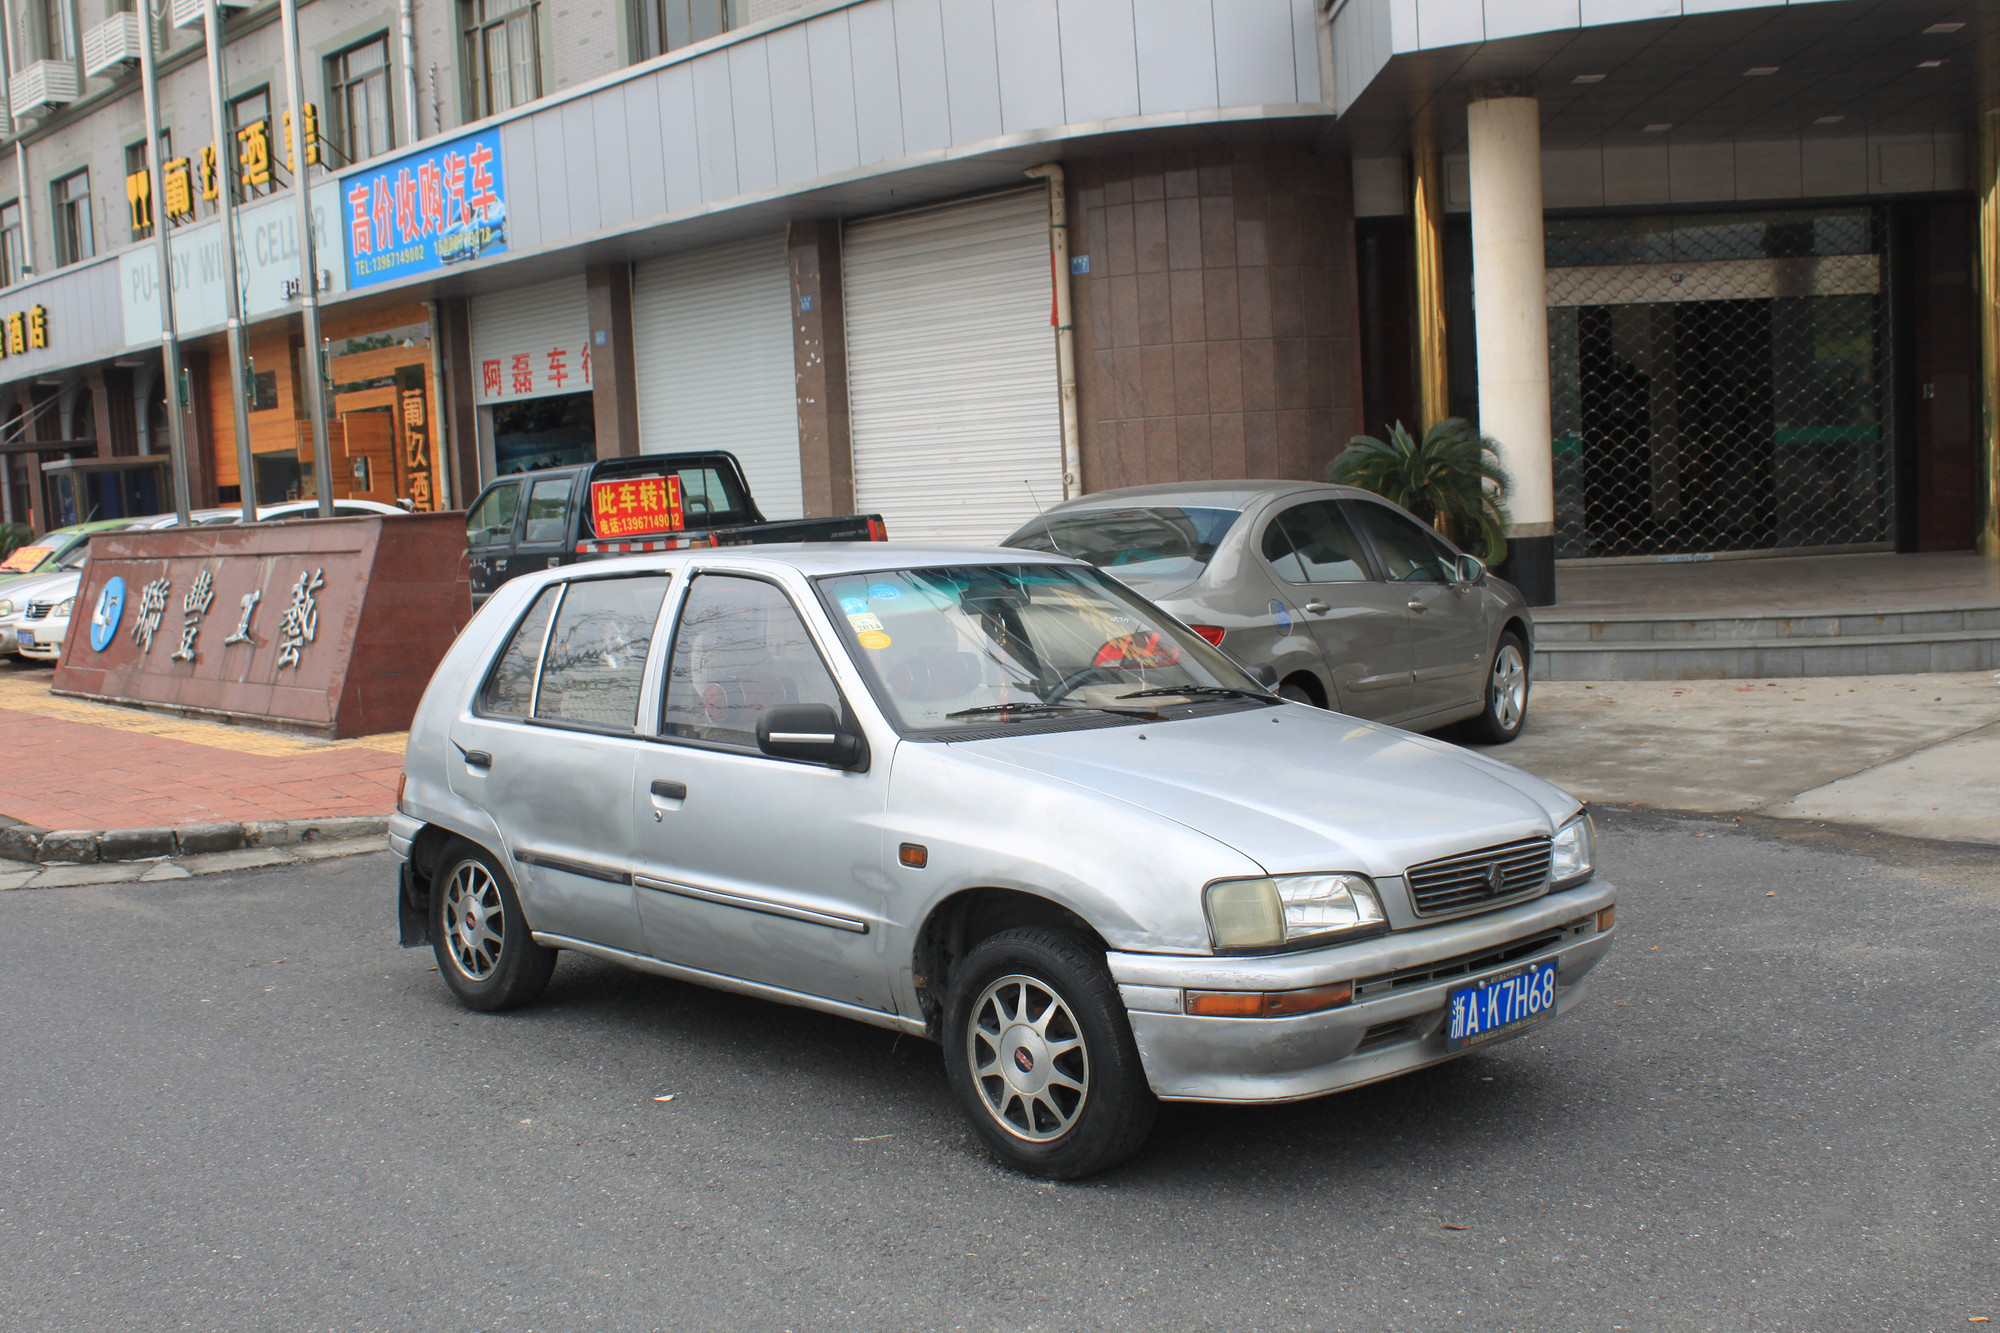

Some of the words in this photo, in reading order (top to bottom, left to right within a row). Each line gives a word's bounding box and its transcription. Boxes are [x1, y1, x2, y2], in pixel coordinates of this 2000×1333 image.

[348, 142, 497, 258] 高价收购汽车
[131, 250, 191, 304] PU-OY
[255, 205, 328, 267] CELLR
[355, 244, 425, 276] TEL:13967149002
[0, 304, 47, 358] 酒店
[598, 480, 679, 514] 此车转让
